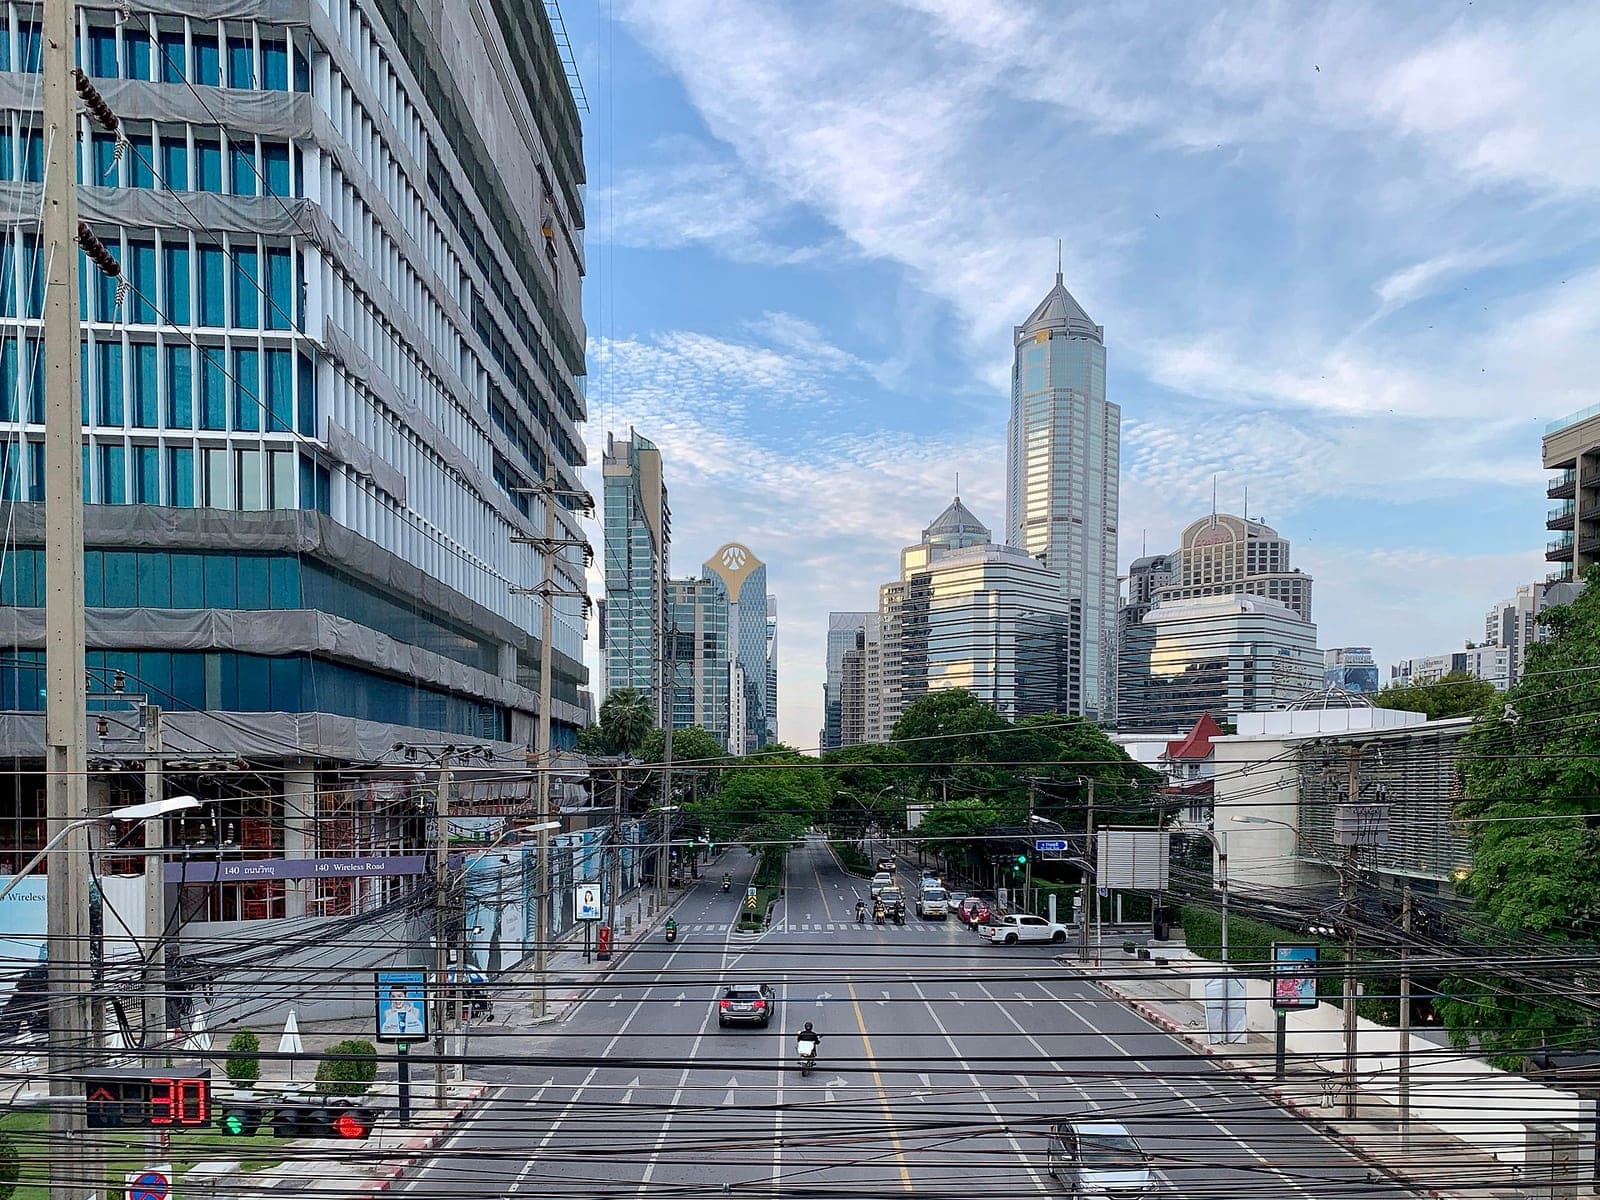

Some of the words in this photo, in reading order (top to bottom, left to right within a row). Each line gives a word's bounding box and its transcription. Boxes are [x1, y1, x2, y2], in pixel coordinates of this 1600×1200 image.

[224, 866, 240, 875] 140
[244, 864, 275, 876] ถนนวิทยุ
[315, 863, 329, 872] 140
[333, 863, 364, 871] Wireless
[366, 862, 385, 870] Road
[8, 892, 46, 901] Wireless
[150, 1078, 205, 1124] 30
